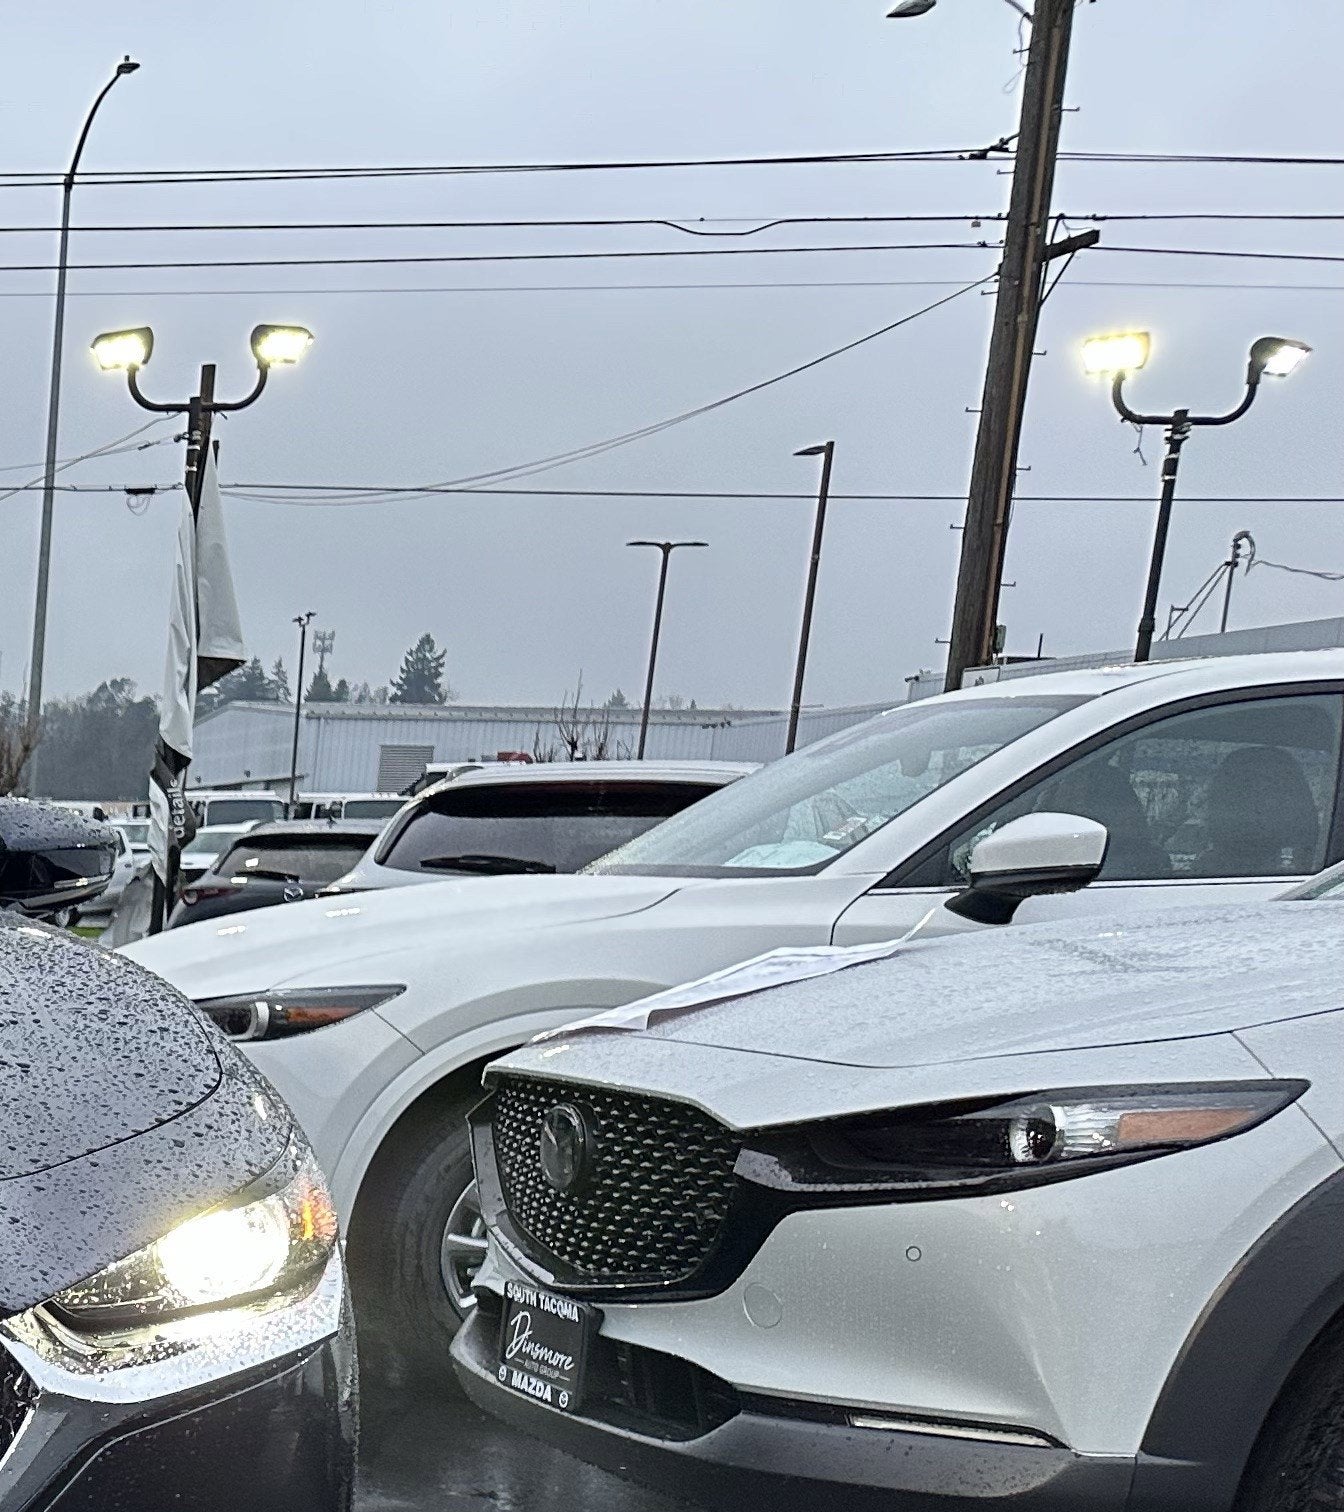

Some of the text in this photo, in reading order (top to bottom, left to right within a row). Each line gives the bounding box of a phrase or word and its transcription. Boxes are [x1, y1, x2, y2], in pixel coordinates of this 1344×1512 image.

[507, 1282, 579, 1323] SOUTH TACOMA
[505, 1311, 575, 1371] Dinsmore
[511, 1370, 552, 1402] MAZDA
